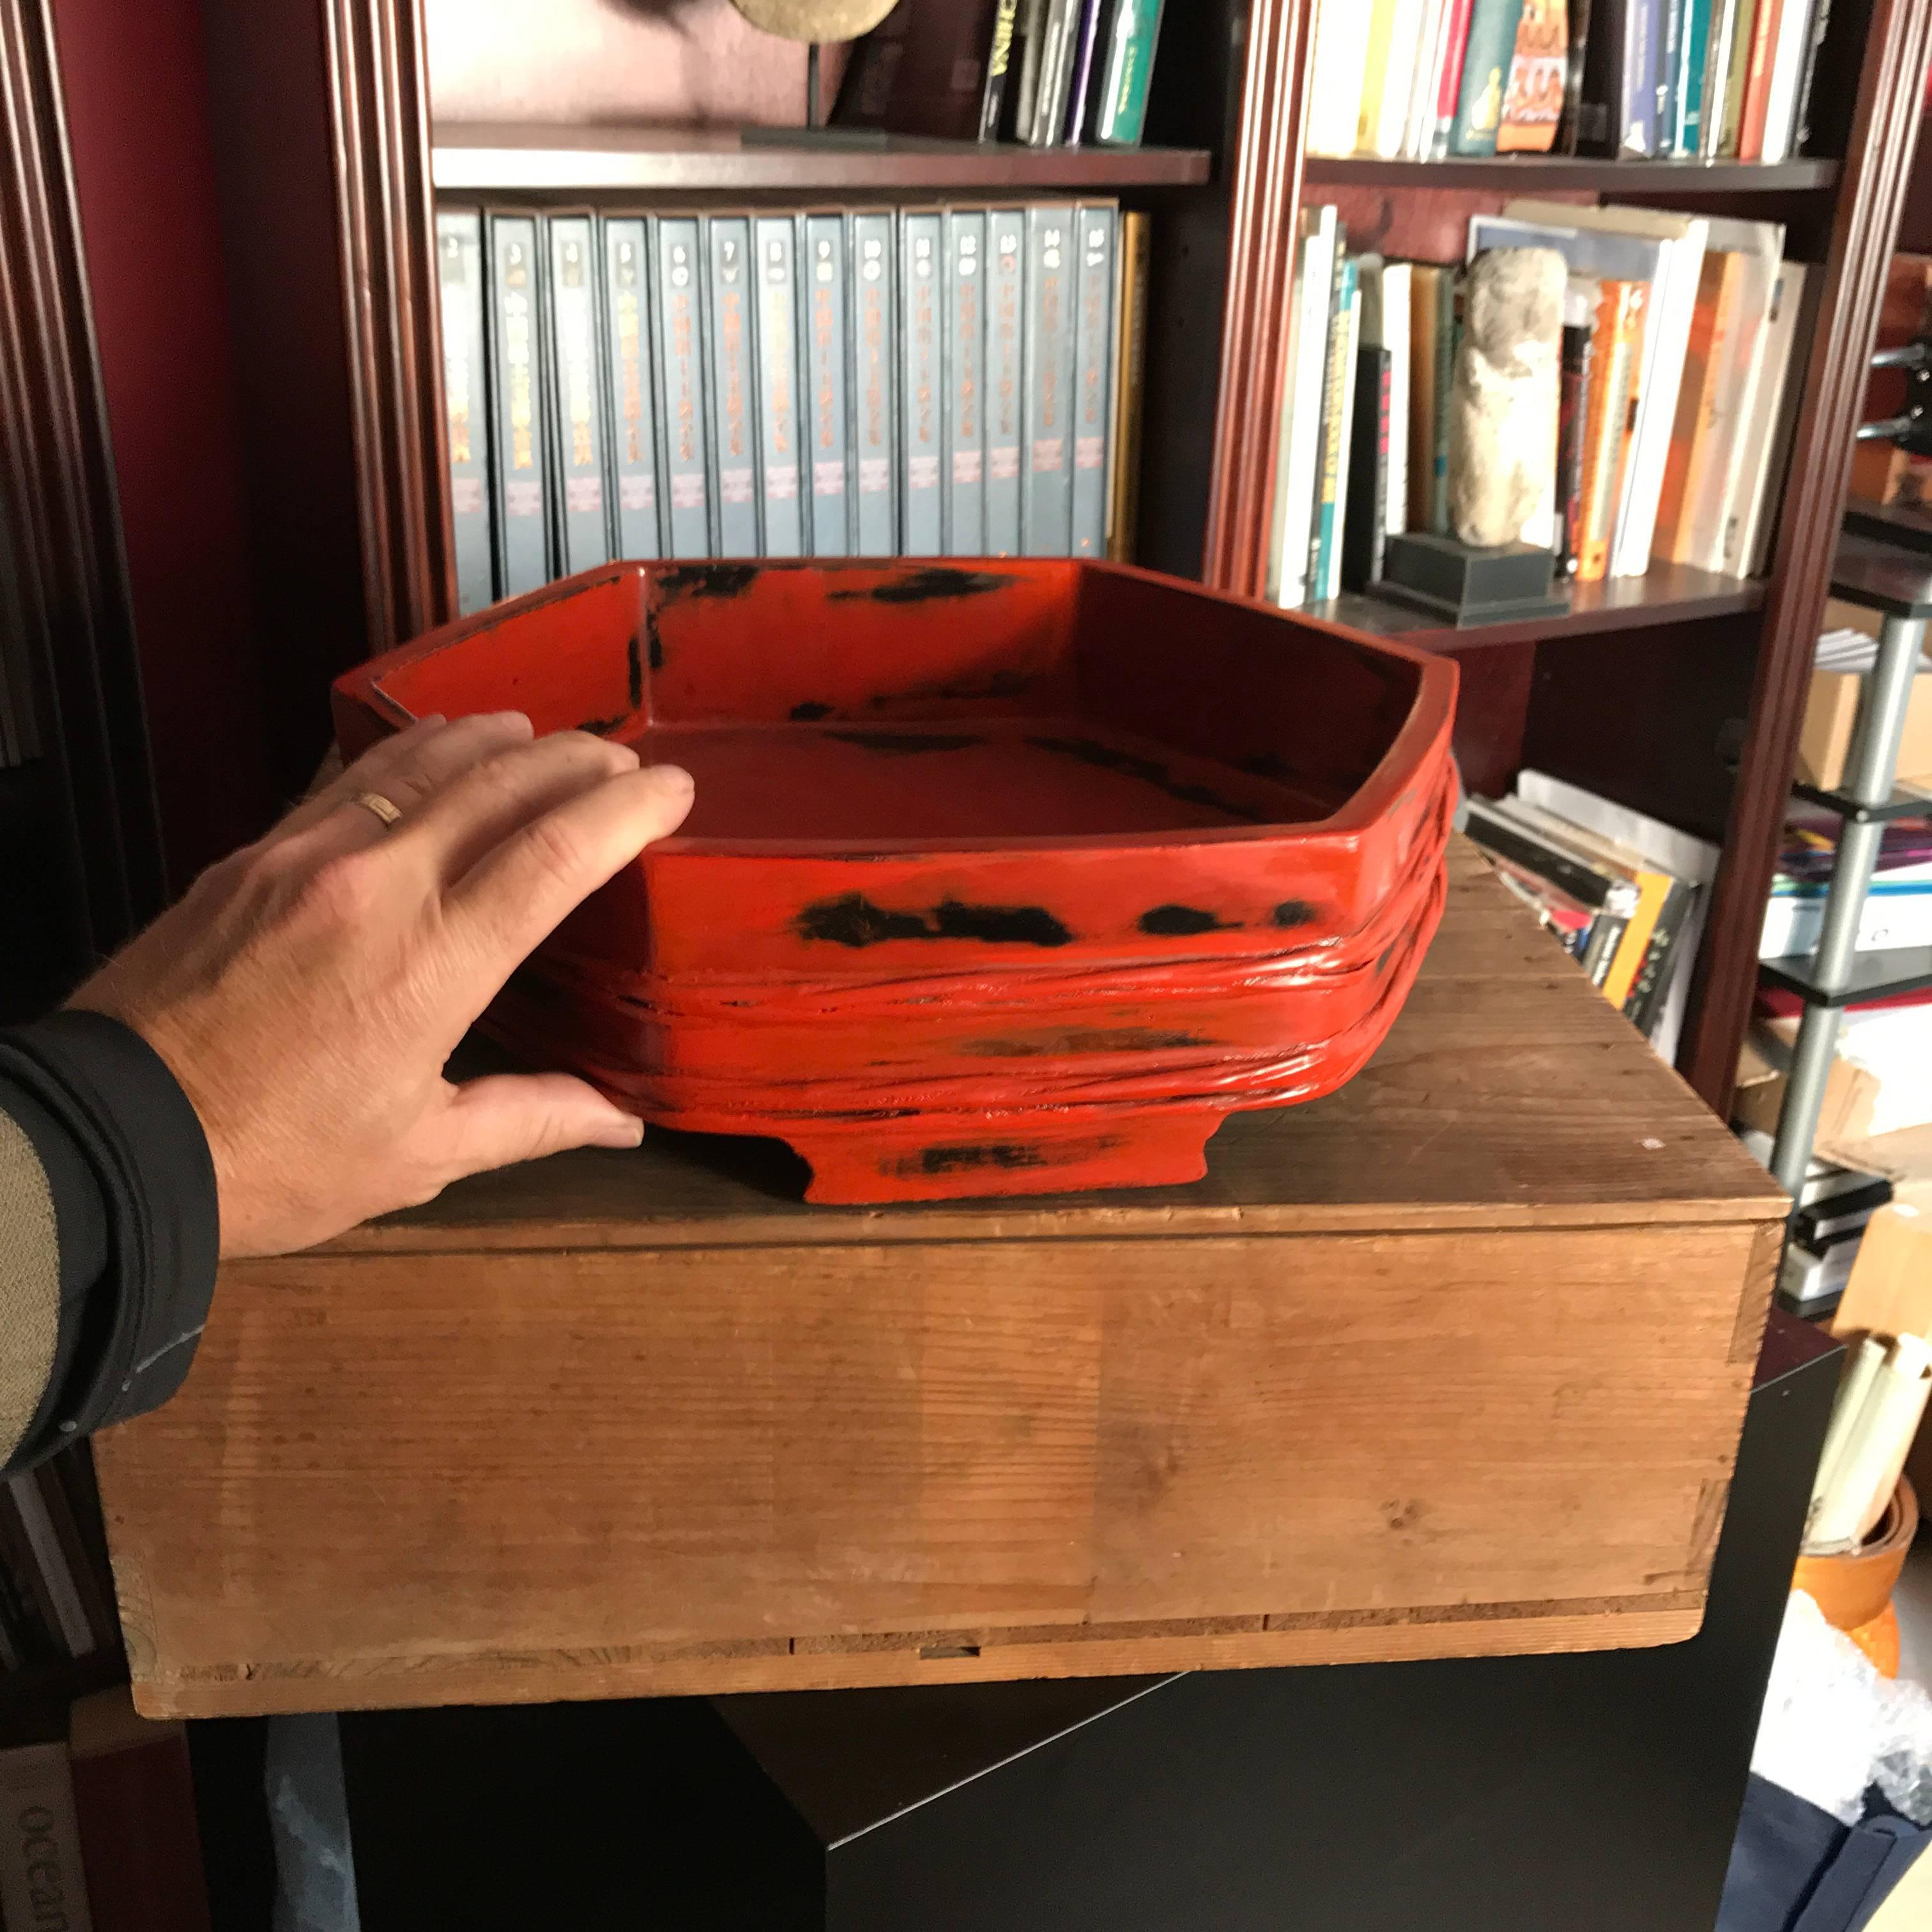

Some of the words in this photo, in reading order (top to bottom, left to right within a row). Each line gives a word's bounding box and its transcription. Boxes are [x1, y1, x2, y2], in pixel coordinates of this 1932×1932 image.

[447, 238, 459, 258] 2
[1044, 229, 1060, 247] 14
[510, 244, 522, 265] 3
[620, 243, 631, 263] 5
[673, 246, 686, 263] 6
[724, 241, 735, 261] 7
[770, 242, 781, 262] 8
[818, 240, 830, 260] 9
